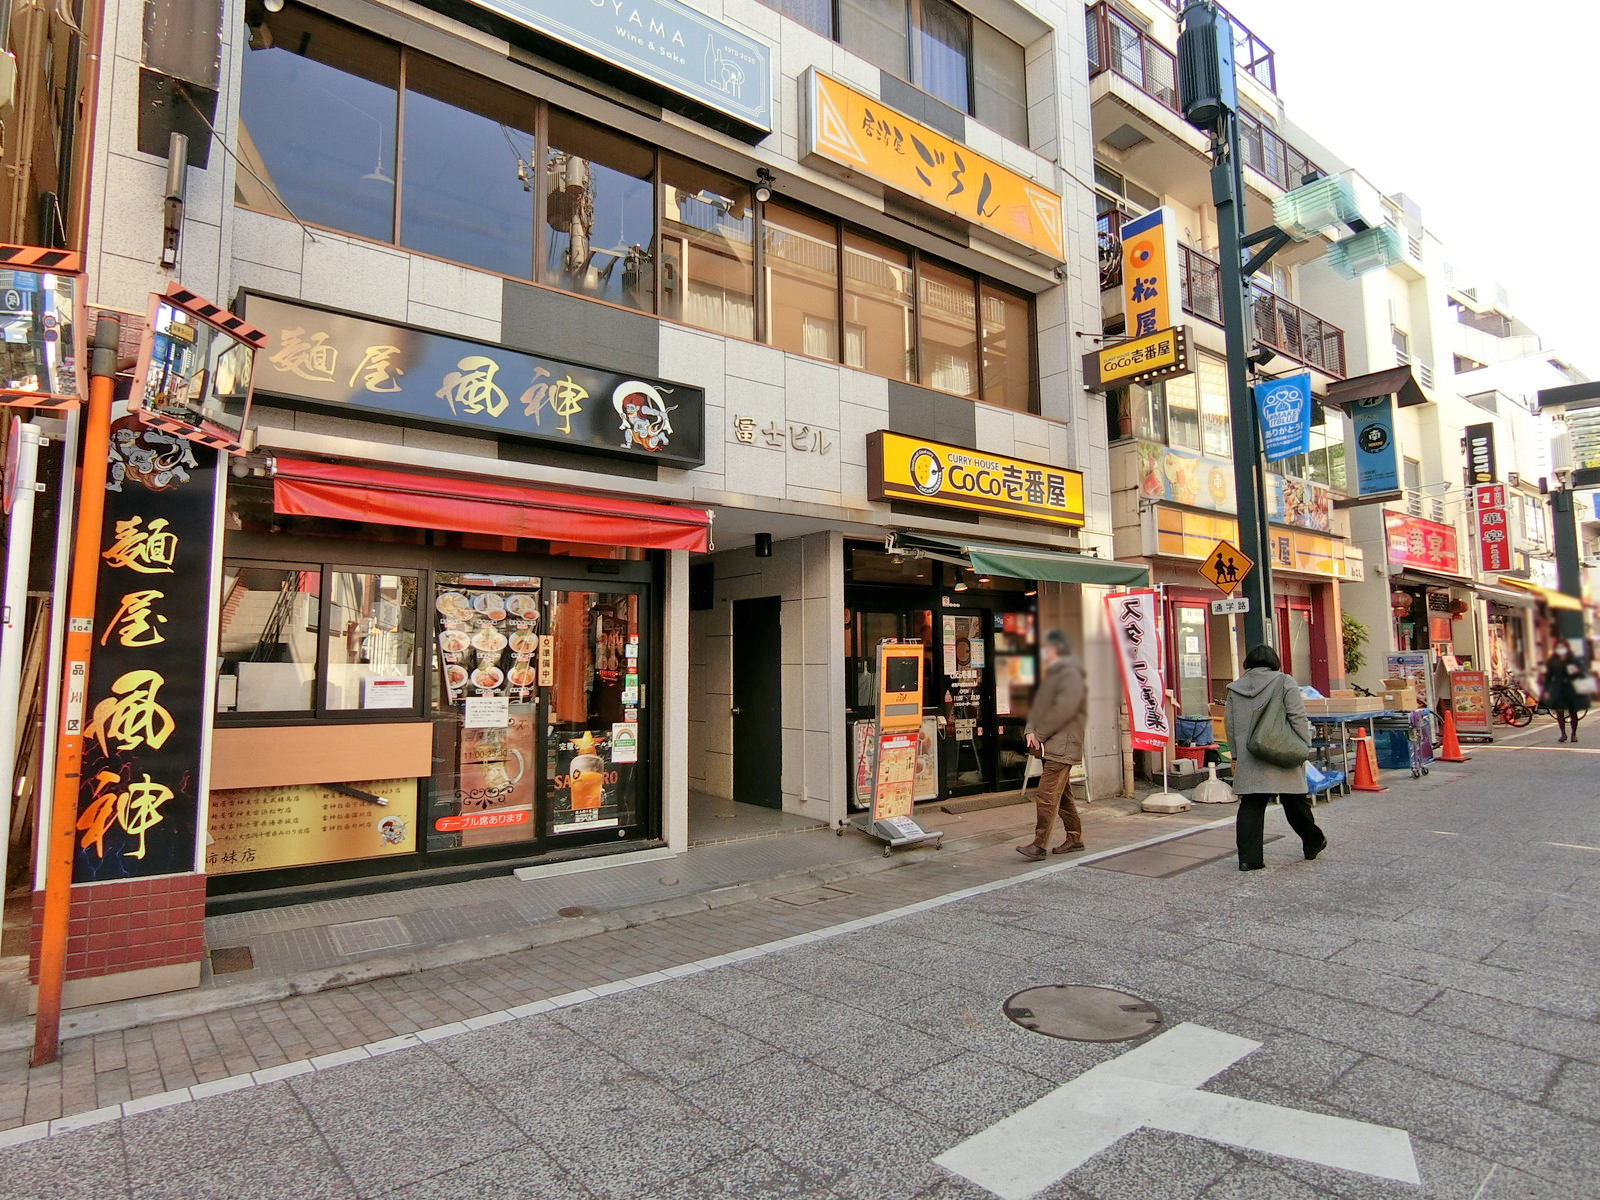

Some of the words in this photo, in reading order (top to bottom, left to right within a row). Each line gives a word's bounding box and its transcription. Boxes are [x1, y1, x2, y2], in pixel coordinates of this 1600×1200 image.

[615, 25, 644, 45] Wine
[647, 42, 656, 52] &
[659, 46, 687, 65] Sake
[909, 132, 1001, 218] ごろん
[1131, 276, 1159, 338] 松屋
[1103, 340, 1171, 372] CoCo壱番屋
[947, 453, 973, 466] CURRY
[974, 459, 1000, 472] HOUSE
[948, 465, 1067, 508] CoCo壱番屋
[1214, 601, 1246, 612] 通学路
[542, 648, 551, 679] 準備中
[67, 664, 84, 731] 品川区
[554, 770, 619, 790] SARO
[440, 811, 524, 830] テーブル席あります
